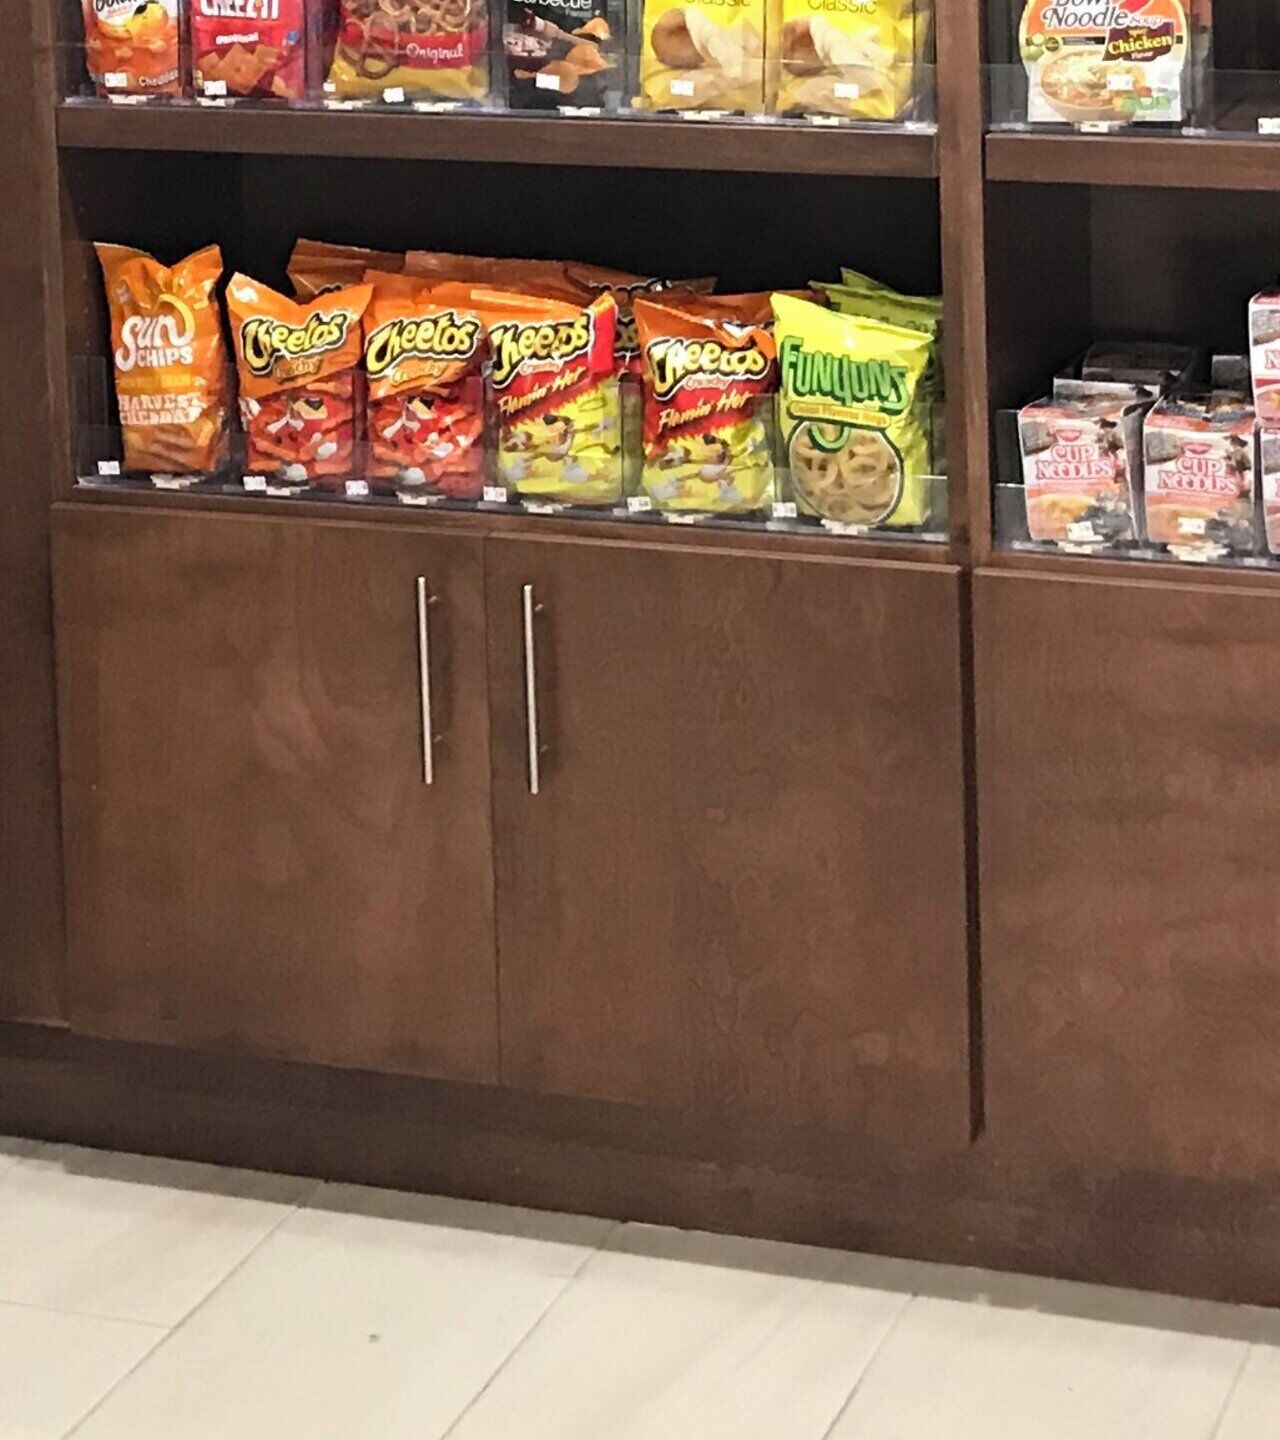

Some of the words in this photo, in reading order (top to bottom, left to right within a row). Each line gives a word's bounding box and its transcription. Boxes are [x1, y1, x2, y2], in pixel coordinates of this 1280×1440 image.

[1041, 7, 1129, 28] Noodle
[1108, 34, 1173, 56] Chicken
[243, 311, 348, 372] Cheetos
[366, 309, 480, 373] Cheetos
[136, 345, 194, 367] CHIPS
[781, 335, 911, 415] FUNYUNS
[1051, 444, 1099, 462] CUP
